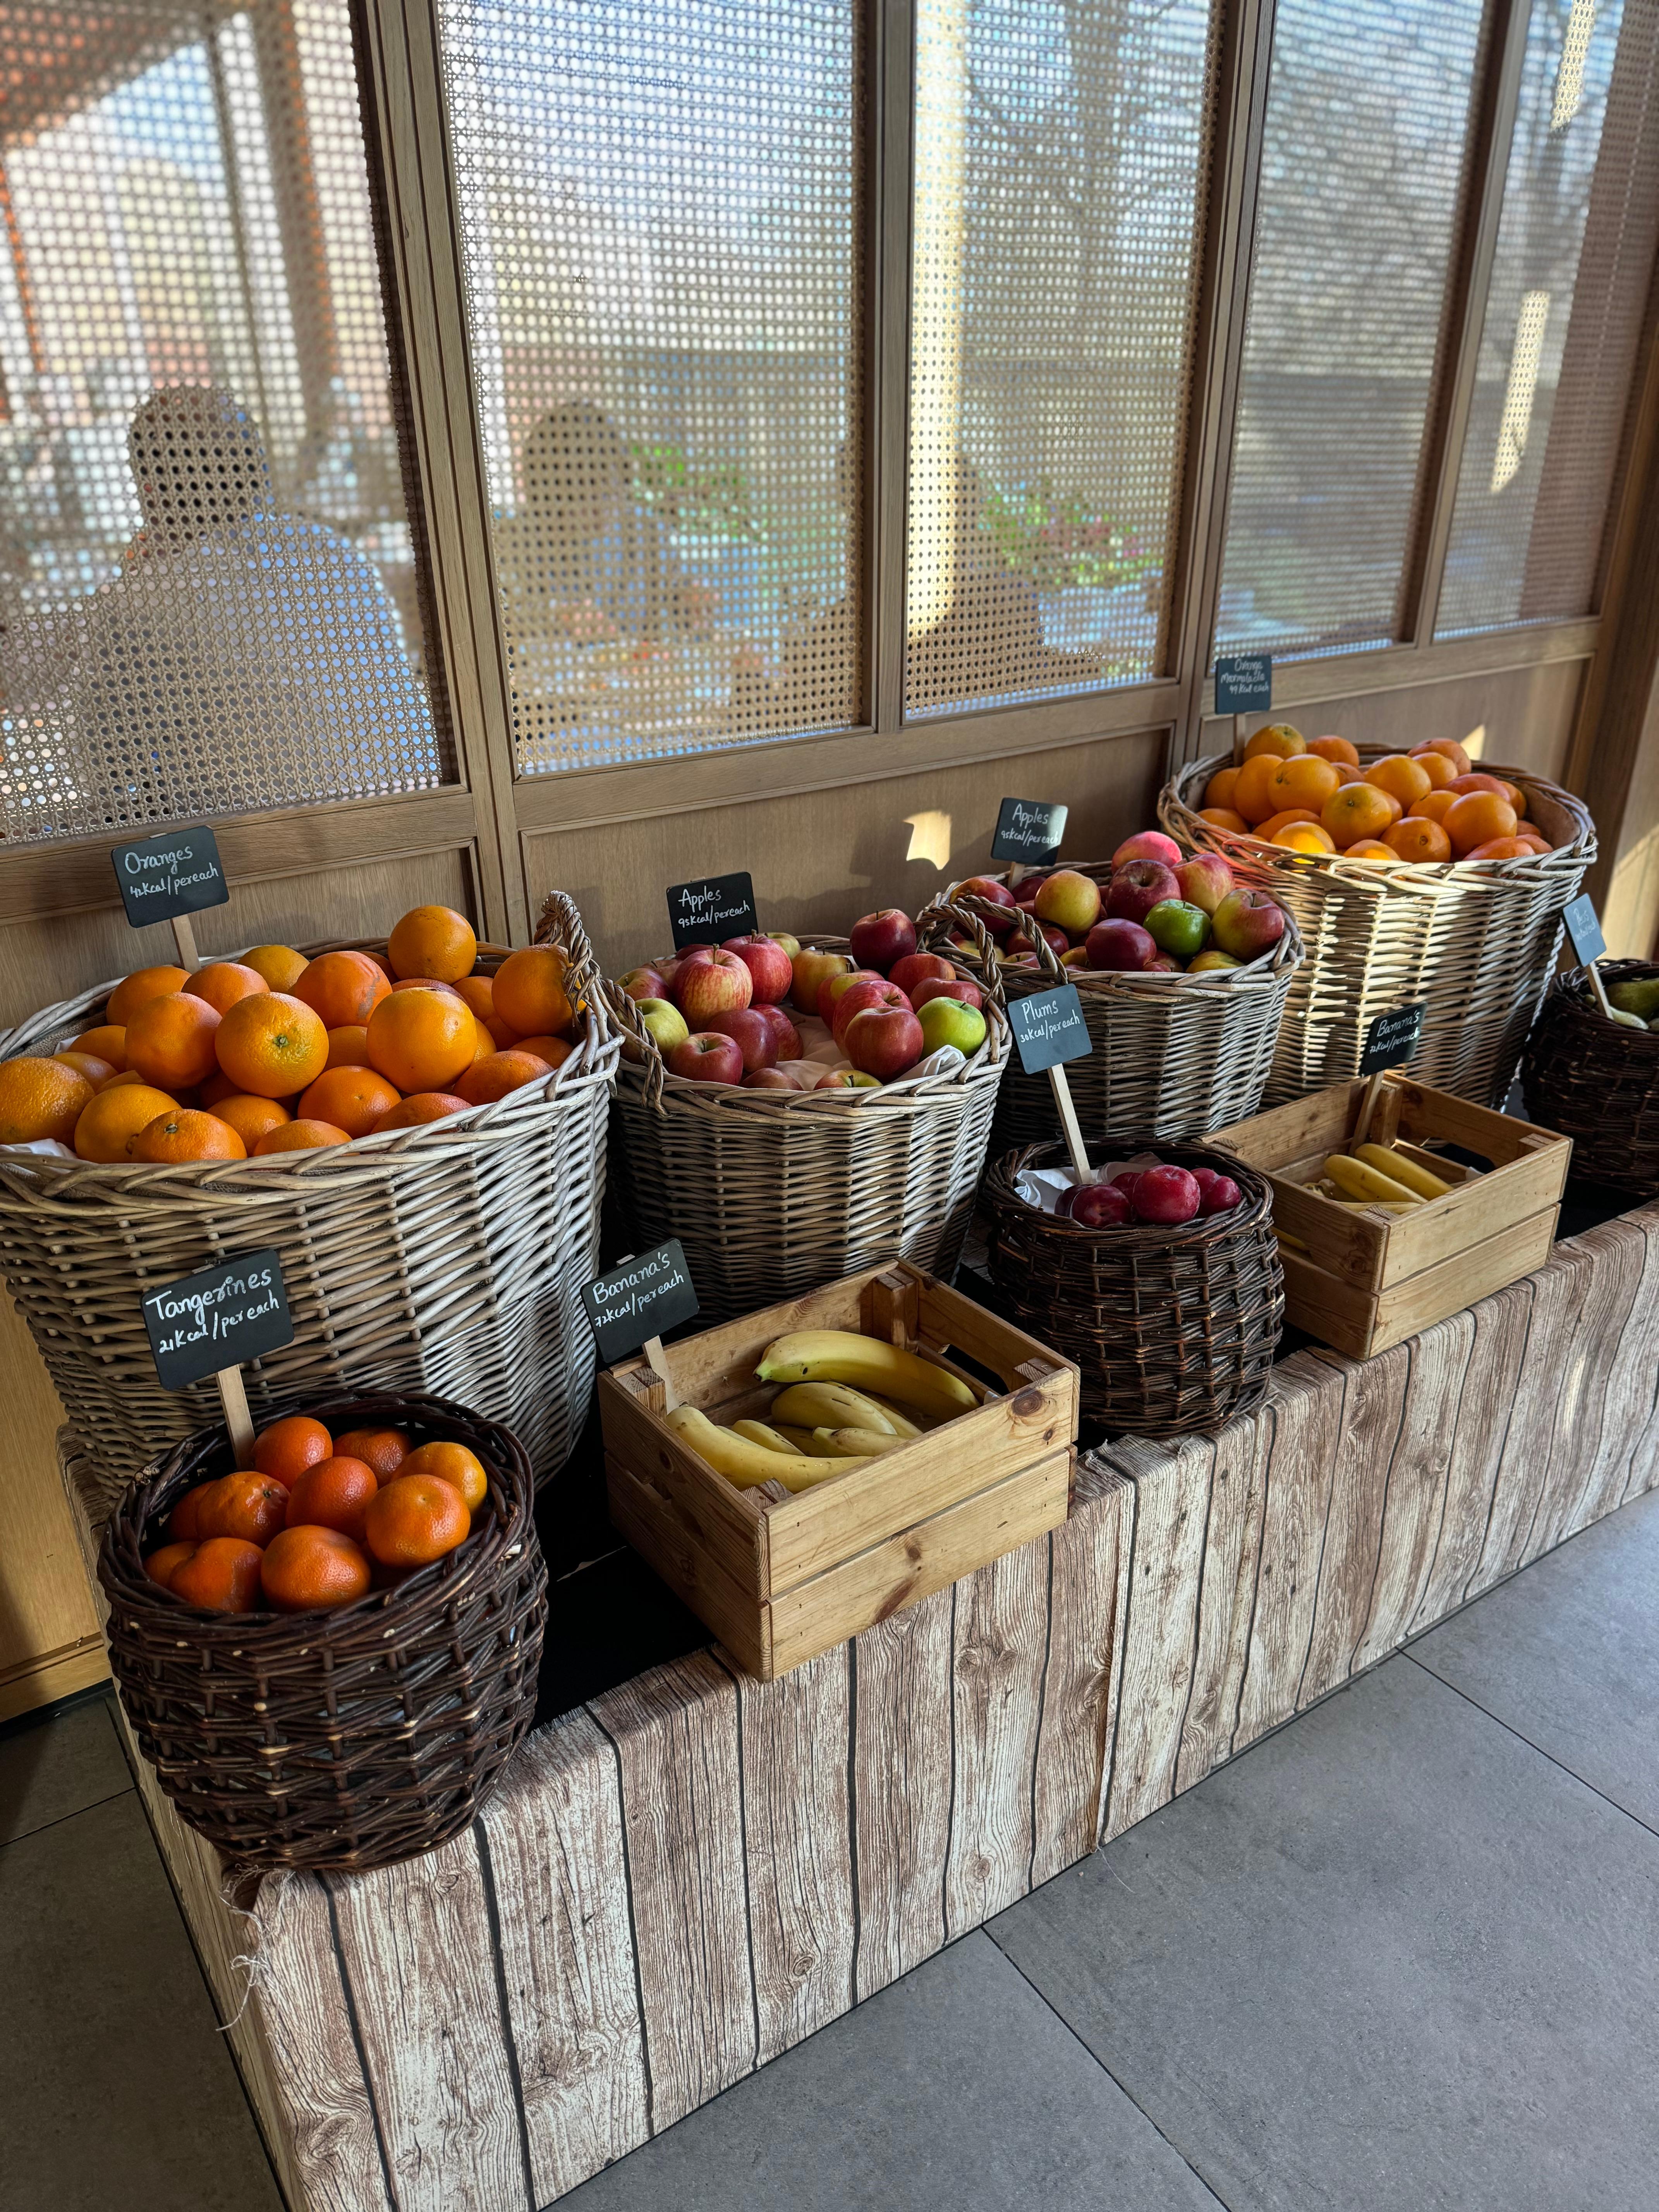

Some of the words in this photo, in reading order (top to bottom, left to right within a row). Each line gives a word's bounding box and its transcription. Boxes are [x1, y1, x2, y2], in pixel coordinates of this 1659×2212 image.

[1012, 803, 1049, 829] Apples
[125, 846, 193, 875] Oranges
[678, 885, 722, 913] Apples
[1022, 1000, 1059, 1024] Plums
[1376, 1010, 1421, 1037] Banana's
[592, 1252, 671, 1304] Banana's
[146, 1269, 272, 1326] Tangerines
